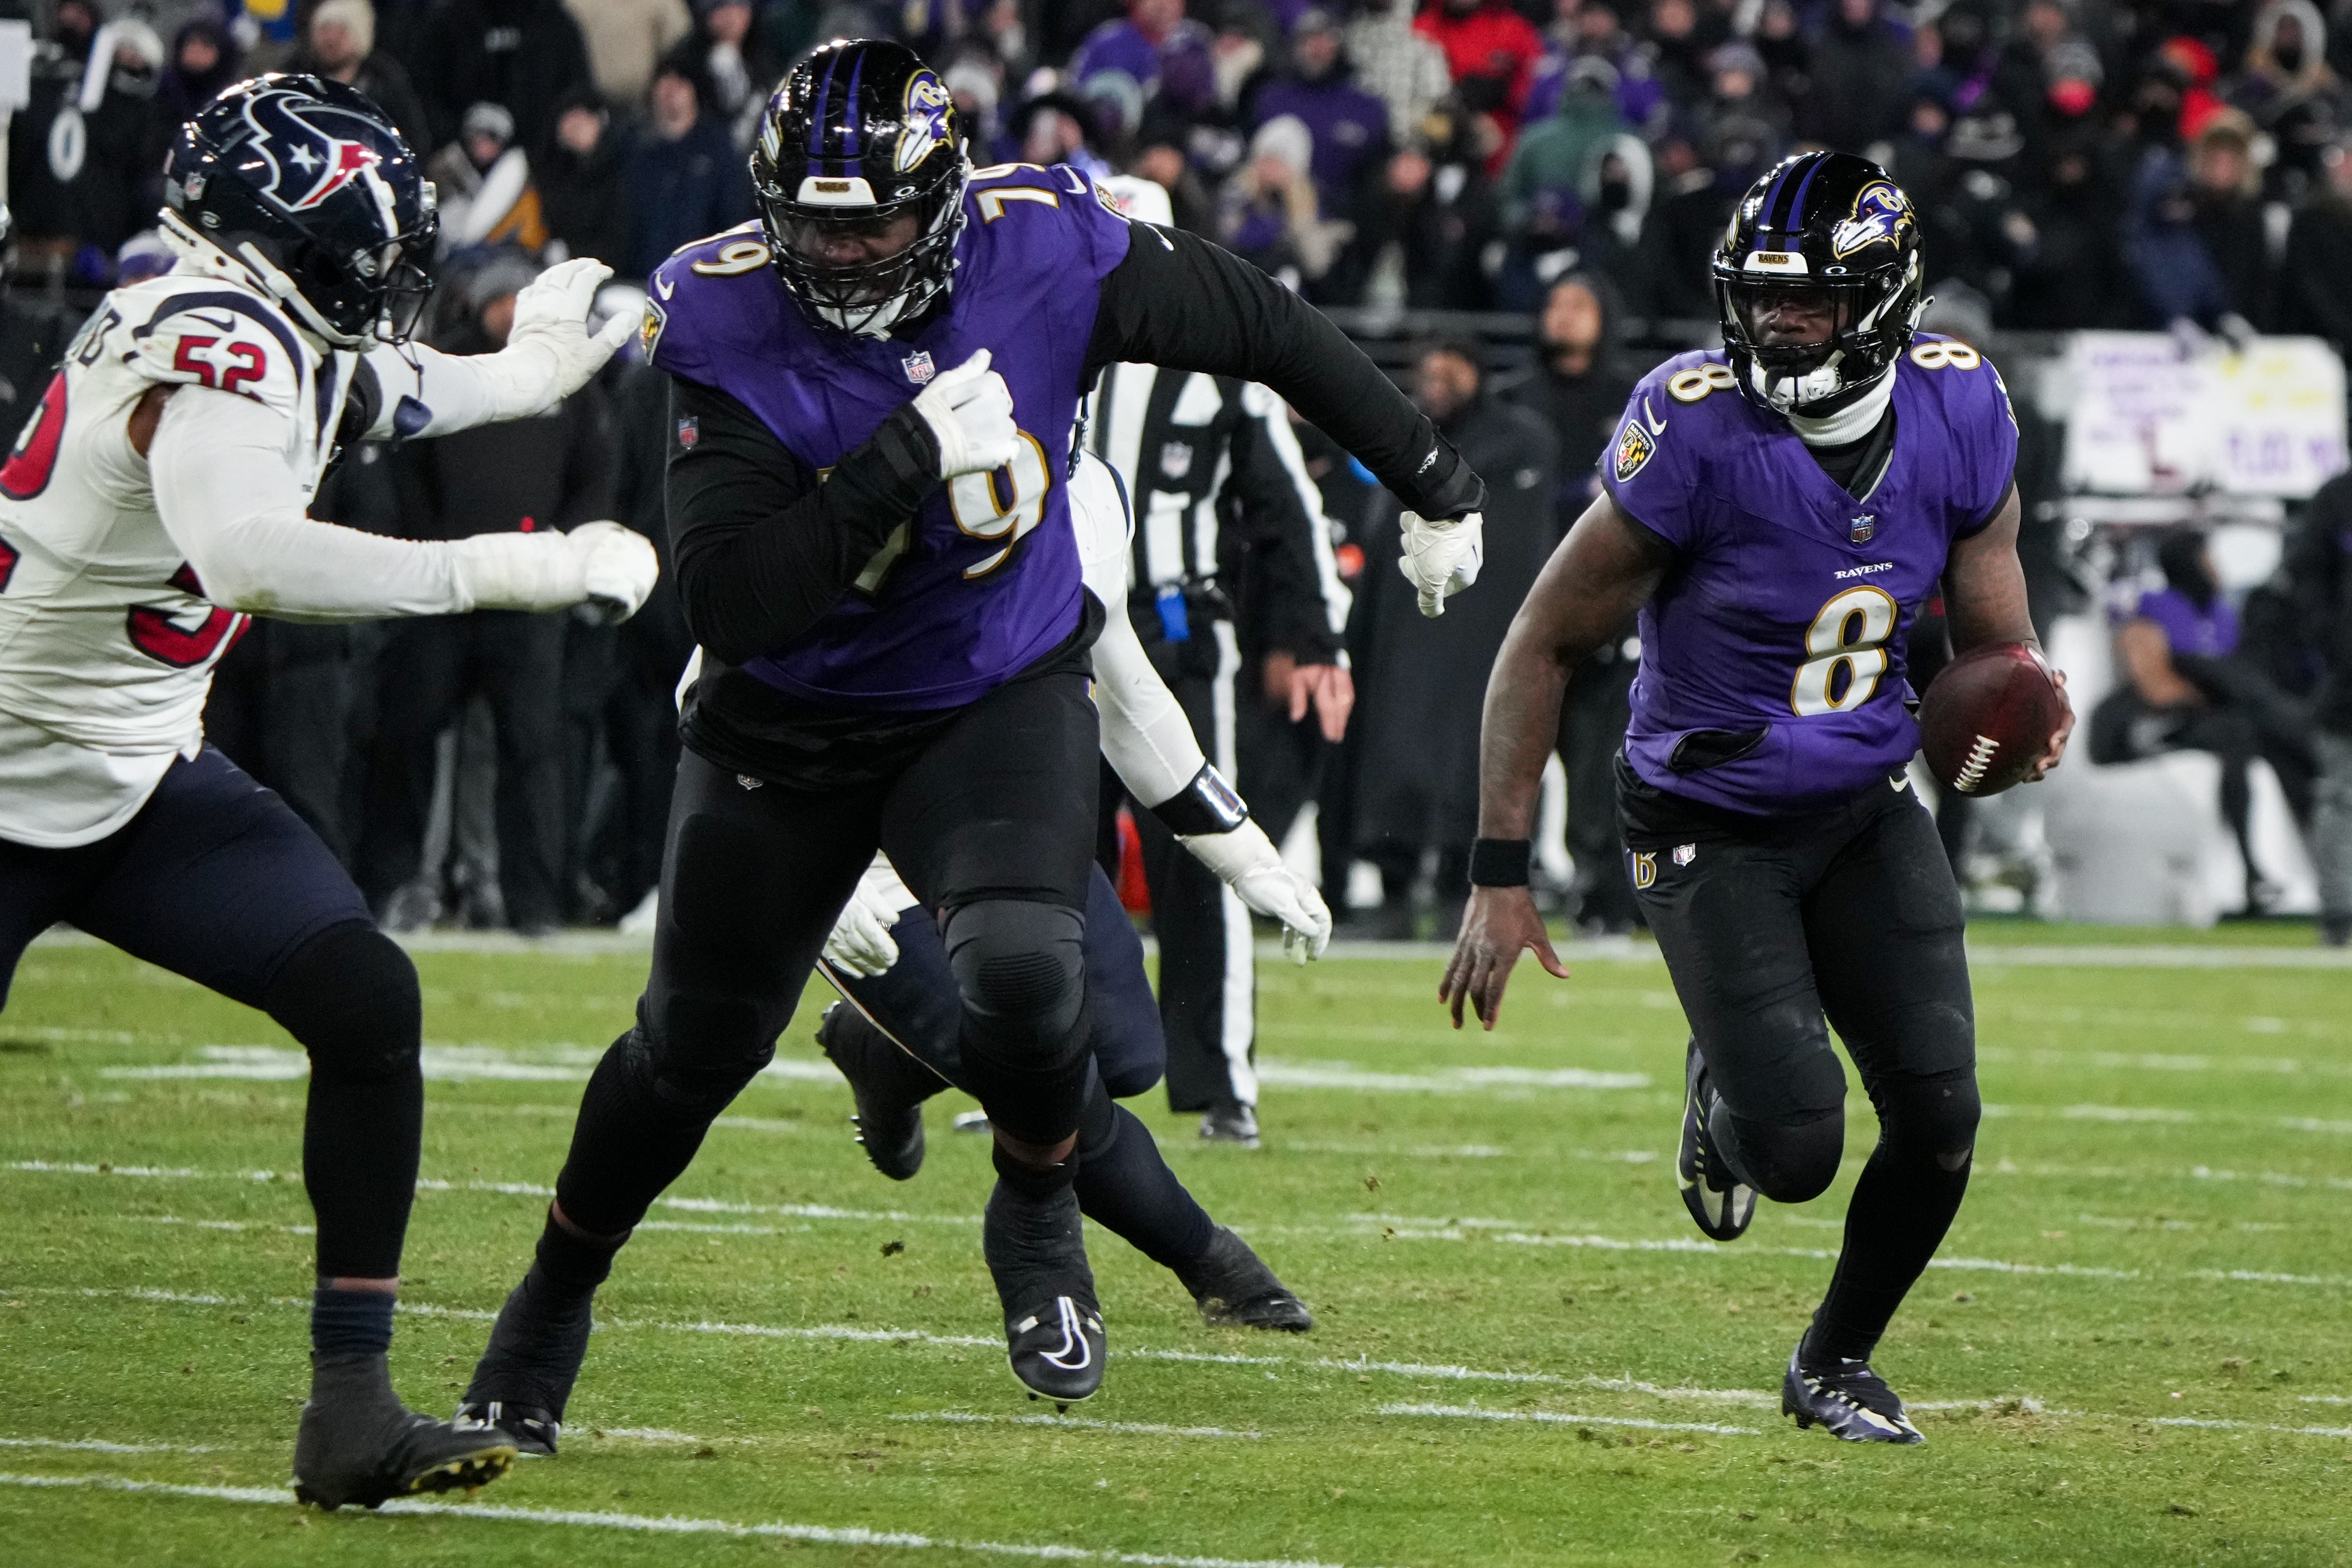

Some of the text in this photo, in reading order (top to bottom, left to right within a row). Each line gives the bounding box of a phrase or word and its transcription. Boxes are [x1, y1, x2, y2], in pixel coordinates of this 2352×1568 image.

[1758, 253, 1790, 264] RAVENS
[174, 335, 267, 404] 52
[1910, 342, 1981, 370] 8
[1668, 363, 1737, 401] 8
[1629, 424, 1651, 450] RAVENS
[1834, 562, 1893, 579] RAVENS
[1791, 585, 1897, 717] 8
